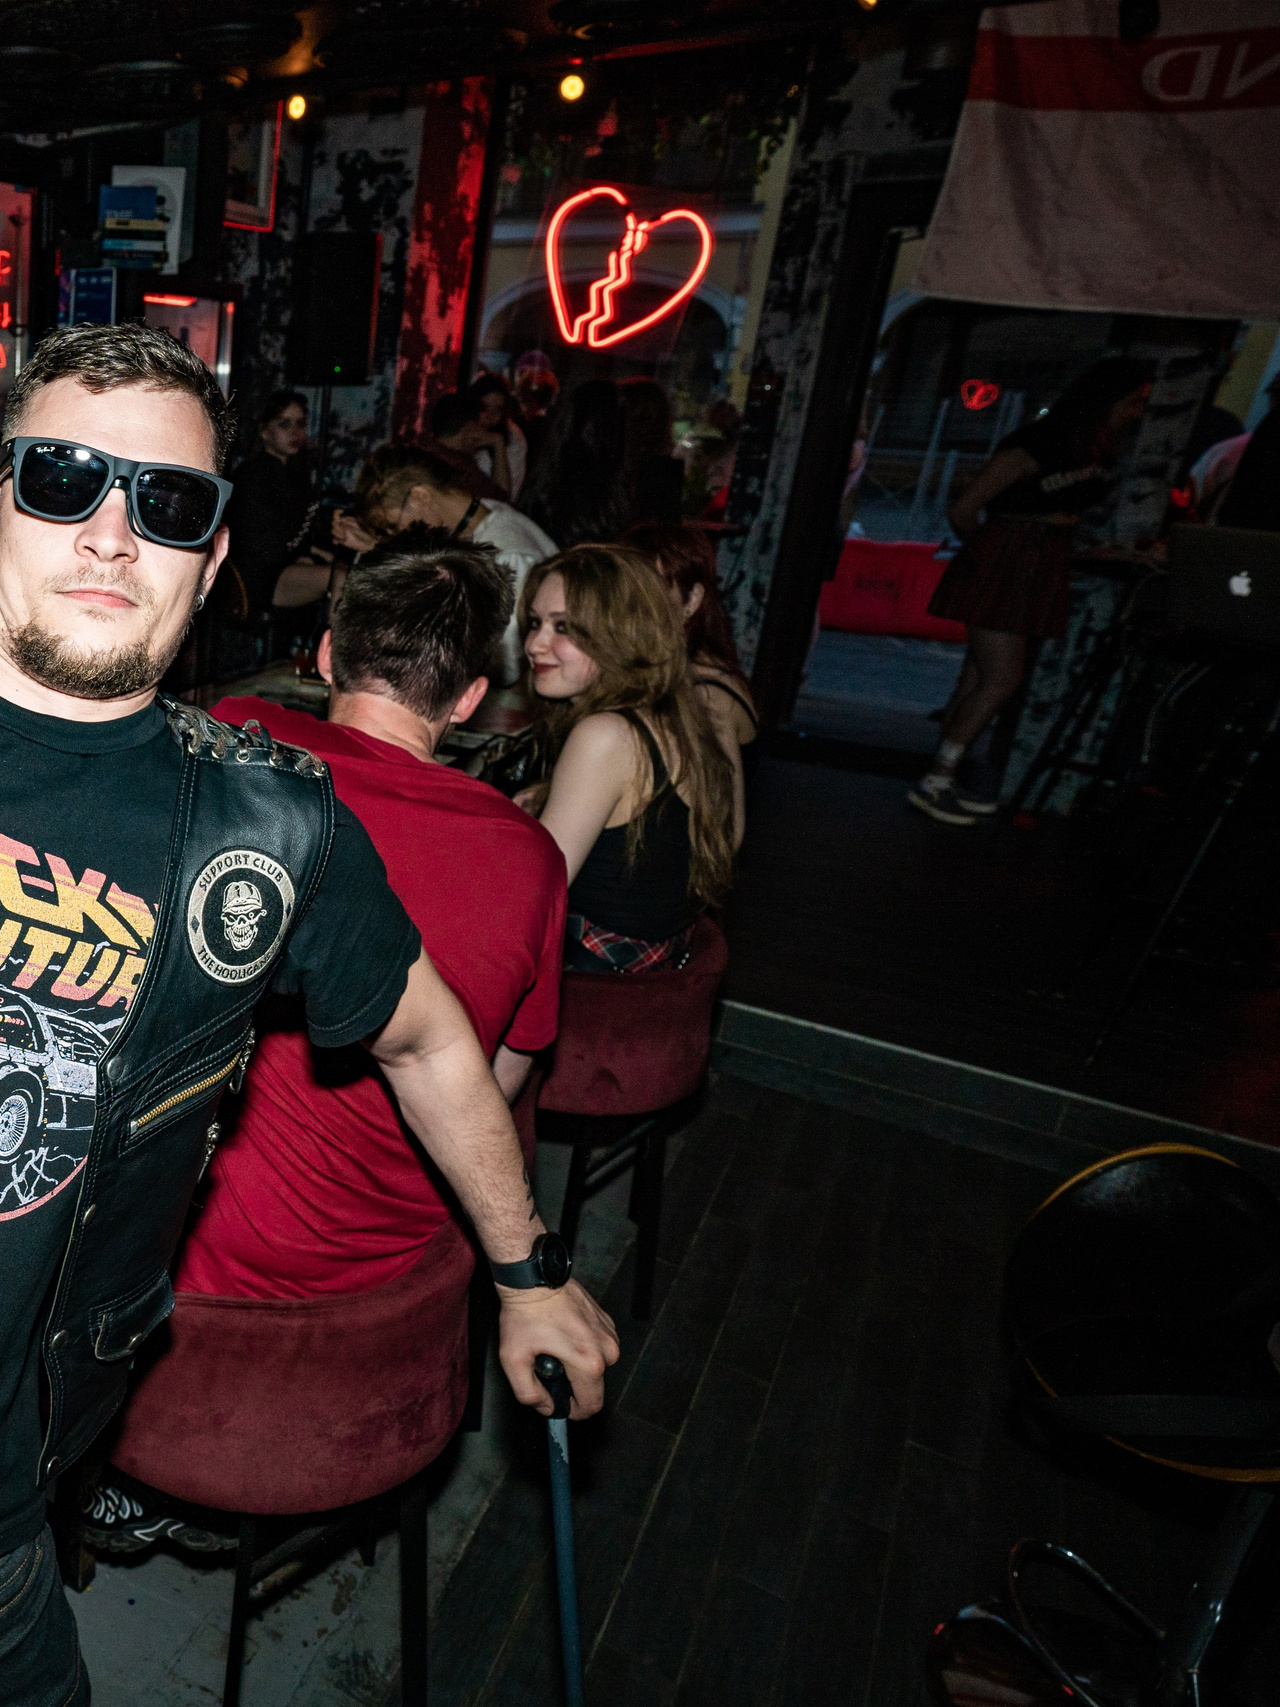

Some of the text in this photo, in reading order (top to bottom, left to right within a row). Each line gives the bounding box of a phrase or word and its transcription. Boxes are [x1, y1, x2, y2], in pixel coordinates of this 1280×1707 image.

[199, 854, 284, 892] SUPPORT CLUB
[197, 945, 217, 970] THE
